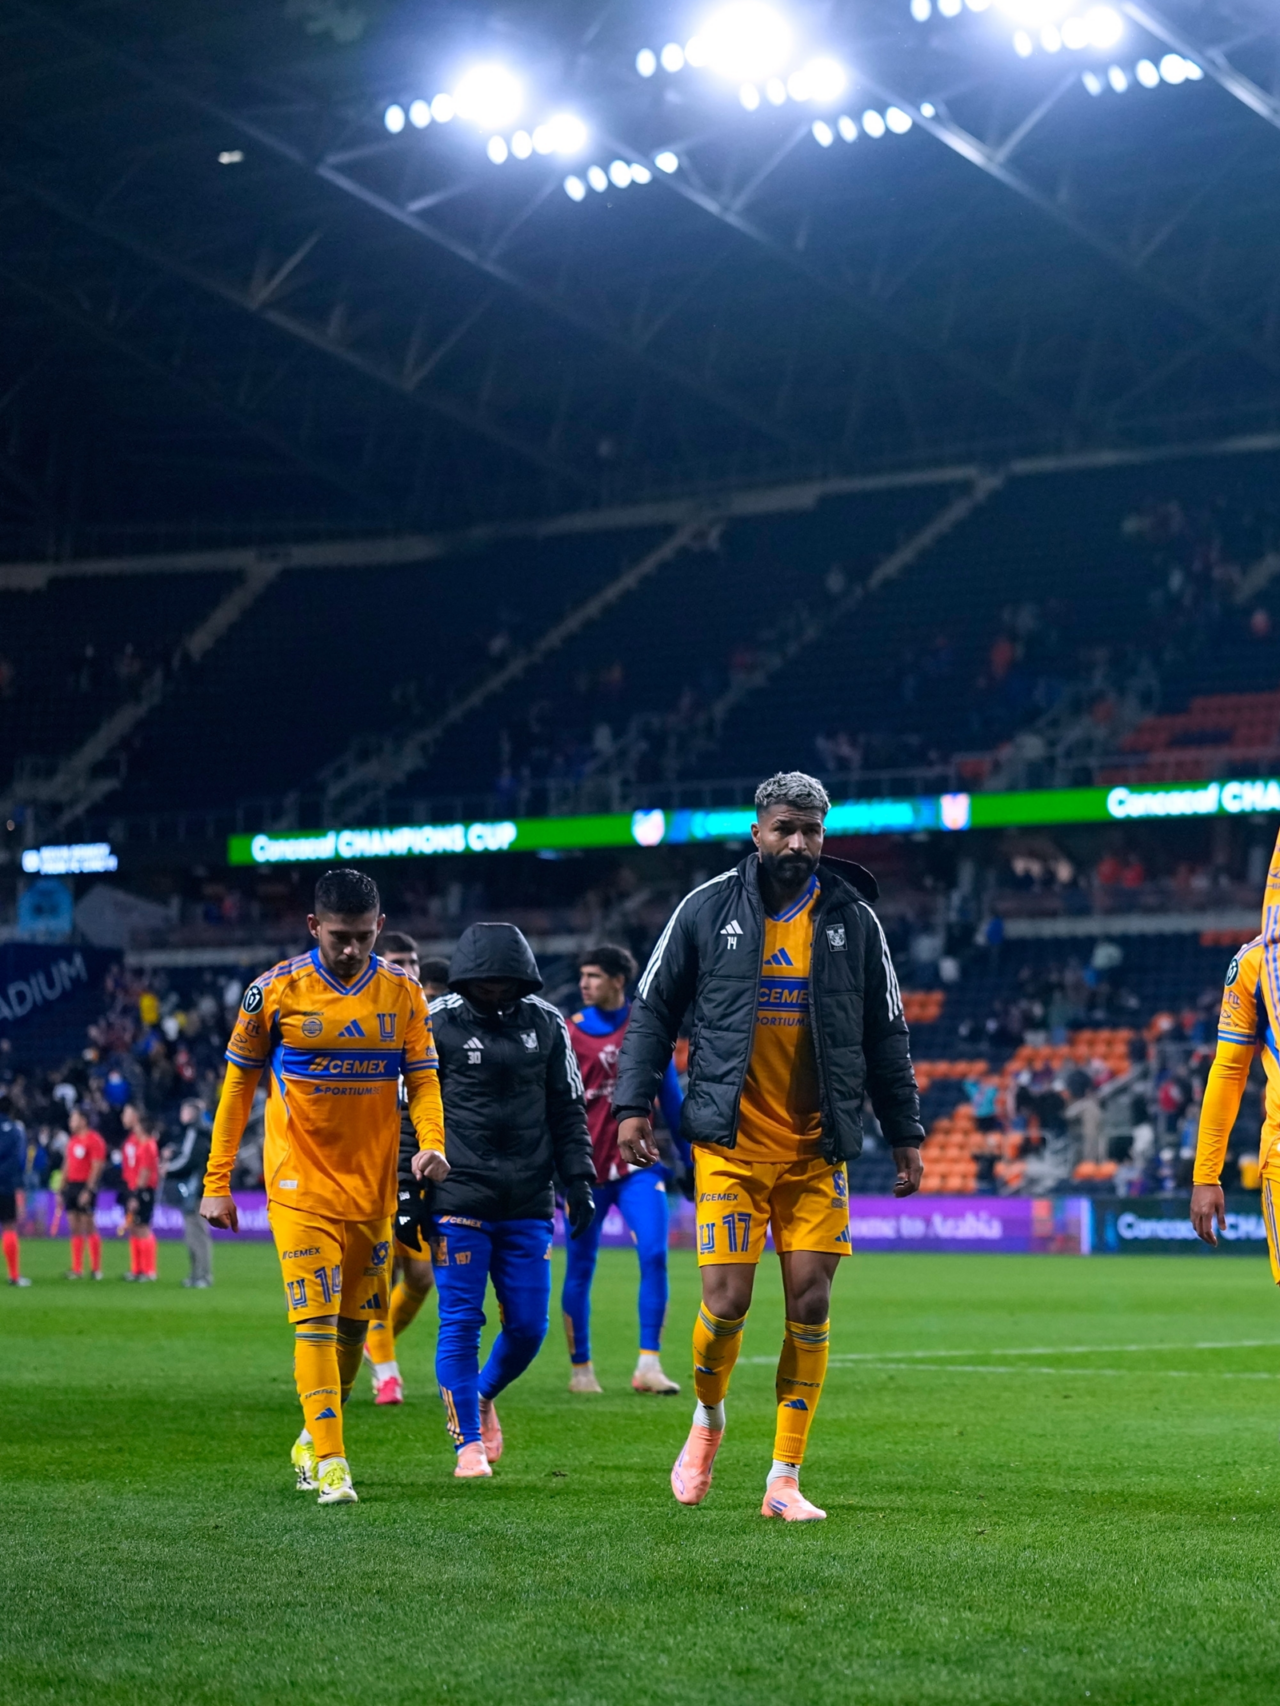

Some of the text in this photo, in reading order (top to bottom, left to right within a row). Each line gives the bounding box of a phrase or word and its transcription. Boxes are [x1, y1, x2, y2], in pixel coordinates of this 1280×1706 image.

[1107, 782, 1220, 818] Concacaf
[337, 824, 466, 858] CHAMPIONS
[467, 821, 517, 852] CUP
[727, 936, 738, 950] 14
[758, 988, 809, 1004] CEME
[755, 1016, 809, 1027] PORTIUM
[467, 1051, 481, 1065] 30
[329, 1059, 387, 1074] CEMEX
[705, 1193, 739, 1202] CEMEX
[449, 1216, 483, 1229] CEMEX
[722, 1212, 753, 1253] 17
[287, 1247, 321, 1259] CEMEX
